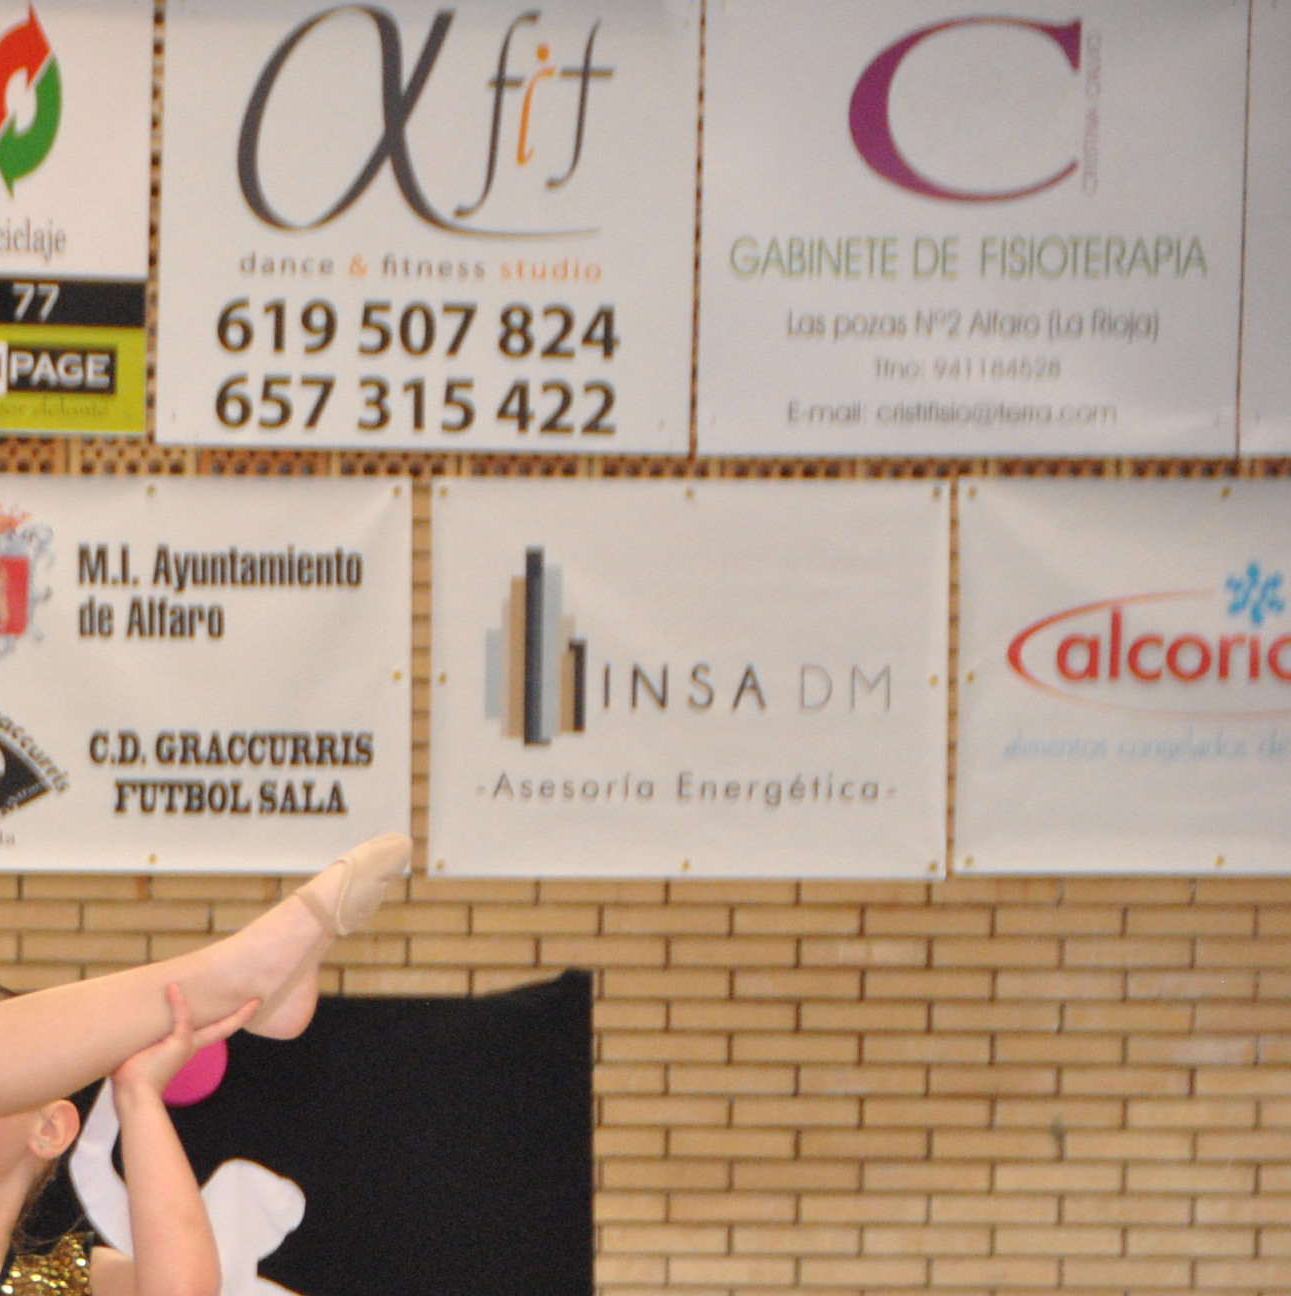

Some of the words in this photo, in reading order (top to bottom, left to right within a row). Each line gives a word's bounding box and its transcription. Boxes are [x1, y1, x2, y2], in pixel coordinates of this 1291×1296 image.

[240, 252, 334, 275] dance
[348, 255, 369, 277] &
[382, 254, 486, 278] fitness
[500, 256, 603, 281] studio
[729, 236, 899, 279] GABINETE
[913, 237, 960, 279] DE
[981, 236, 1209, 279] FISIOTERAPIA
[13, 283, 60, 320] 77
[217, 298, 338, 353] 619
[357, 301, 477, 356] 507
[497, 305, 618, 359] 824
[786, 311, 826, 336] Las
[833, 316, 907, 341] pozas
[969, 311, 1041, 337] Alfaro
[1089, 310, 1160, 342] Rioja)
[216, 374, 336, 429] 657
[357, 376, 476, 431] 315
[496, 379, 617, 434] 422
[78, 544, 139, 585] M.I.
[153, 546, 362, 592] Ayuntamiento
[79, 602, 114, 638] de
[127, 602, 226, 639] Alfaro
[603, 663, 767, 710] INSA
[799, 664, 892, 710] DM
[89, 731, 147, 767] C.D.
[155, 732, 375, 767] GRACCURRIS
[114, 780, 251, 815] FUTBOL
[259, 781, 349, 815] SALA
